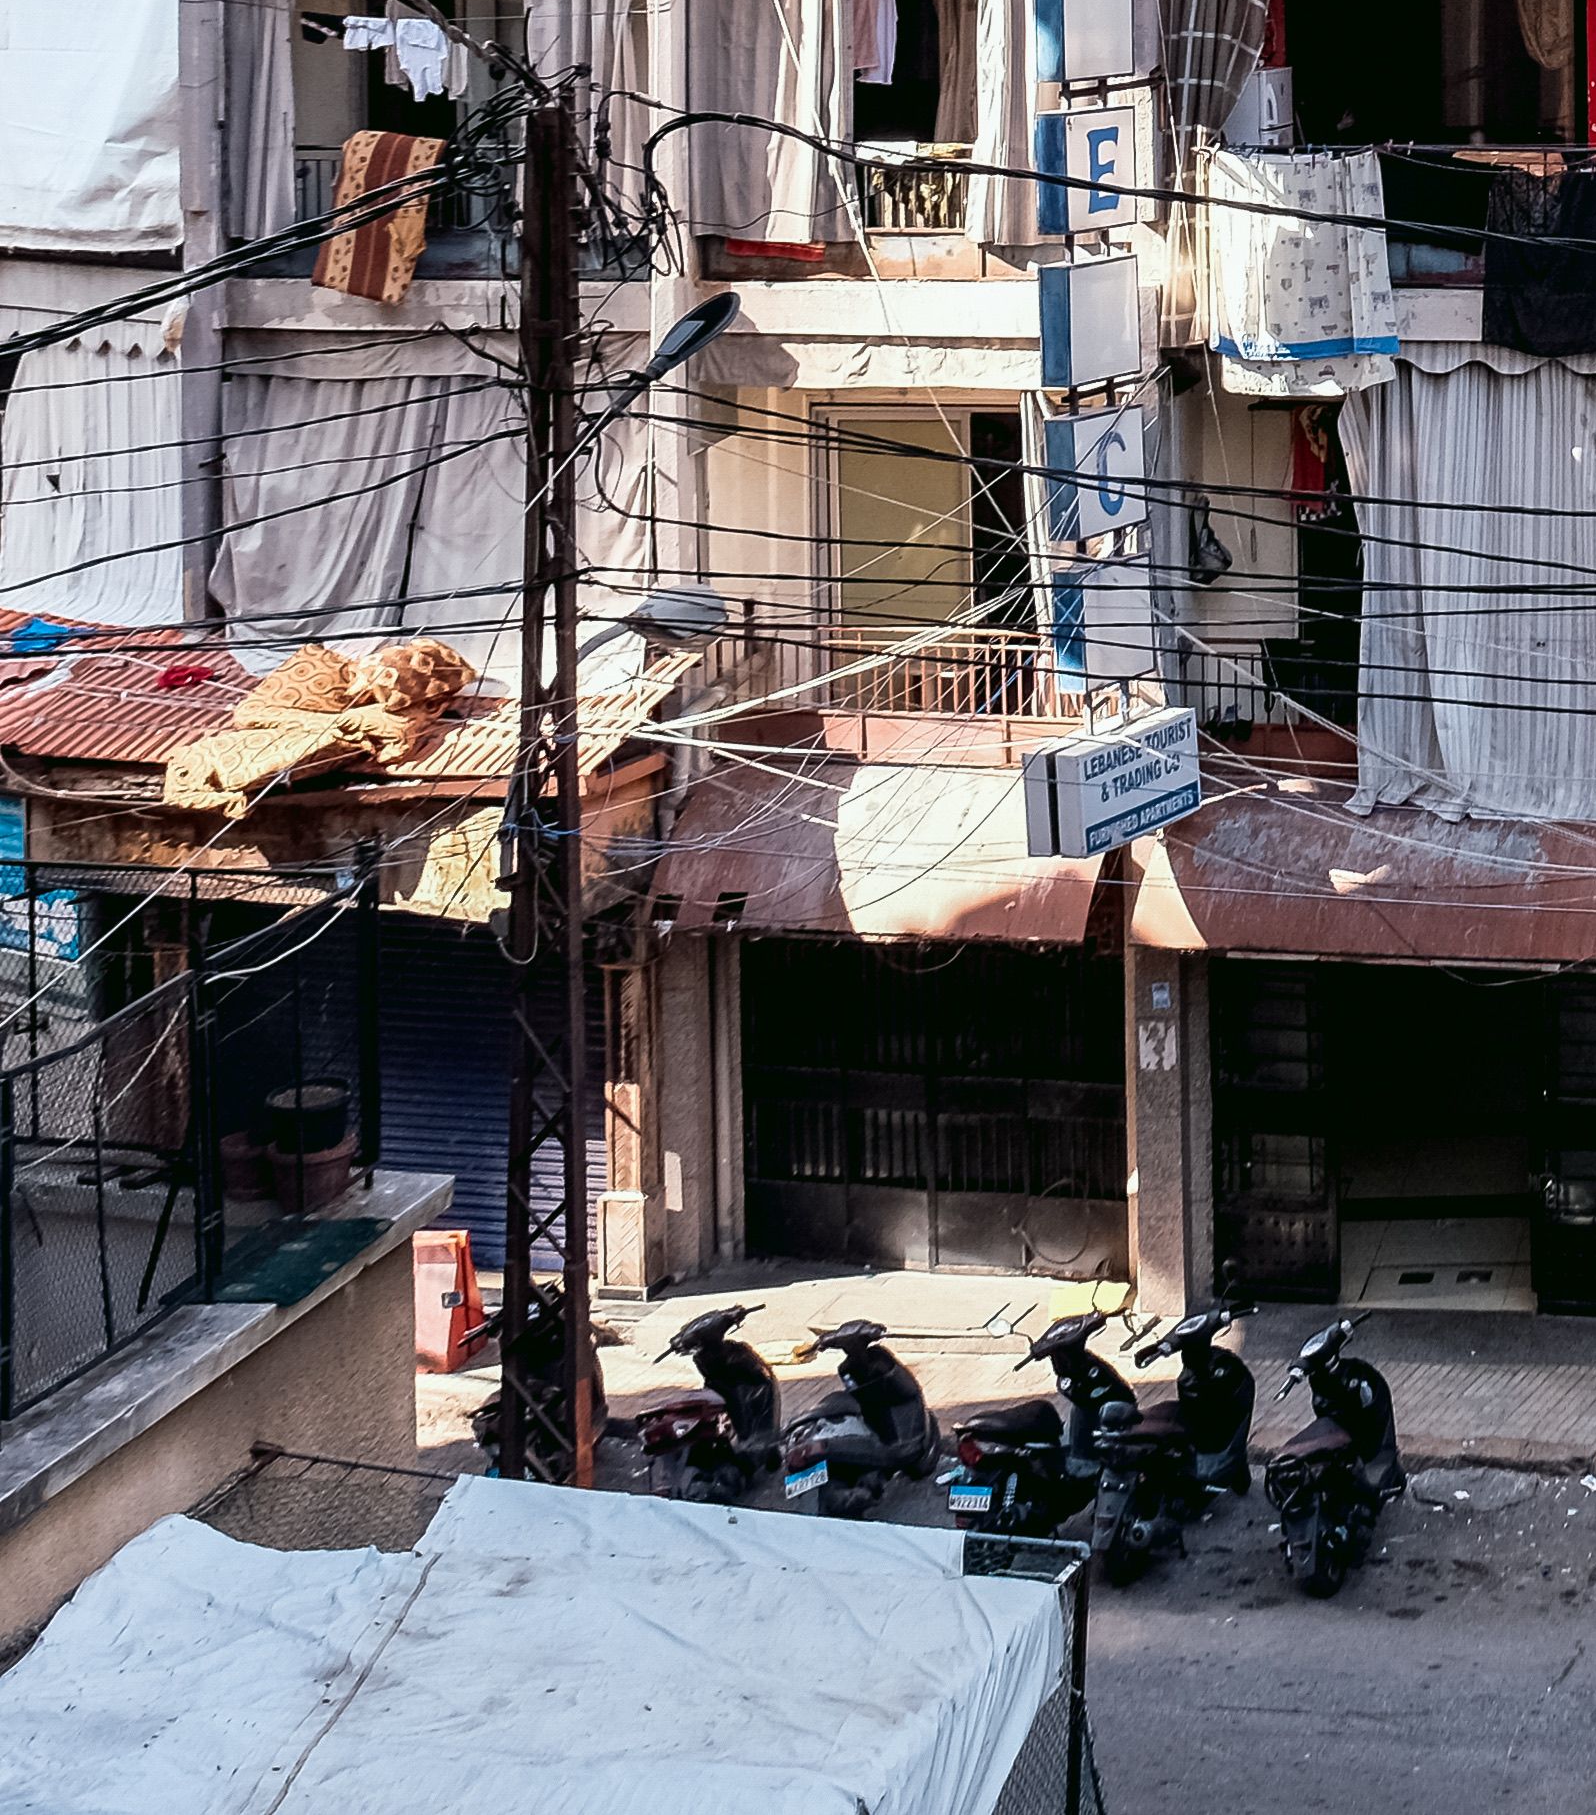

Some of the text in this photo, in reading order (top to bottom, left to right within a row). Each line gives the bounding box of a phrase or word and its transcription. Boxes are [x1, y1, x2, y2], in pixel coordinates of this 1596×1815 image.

[1088, 126, 1119, 215] E
[1096, 431, 1127, 517] C
[1084, 718, 1192, 781] LEBANESE TOURIST
[1100, 781, 1110, 803] &
[1113, 762, 1162, 796] TRADING
